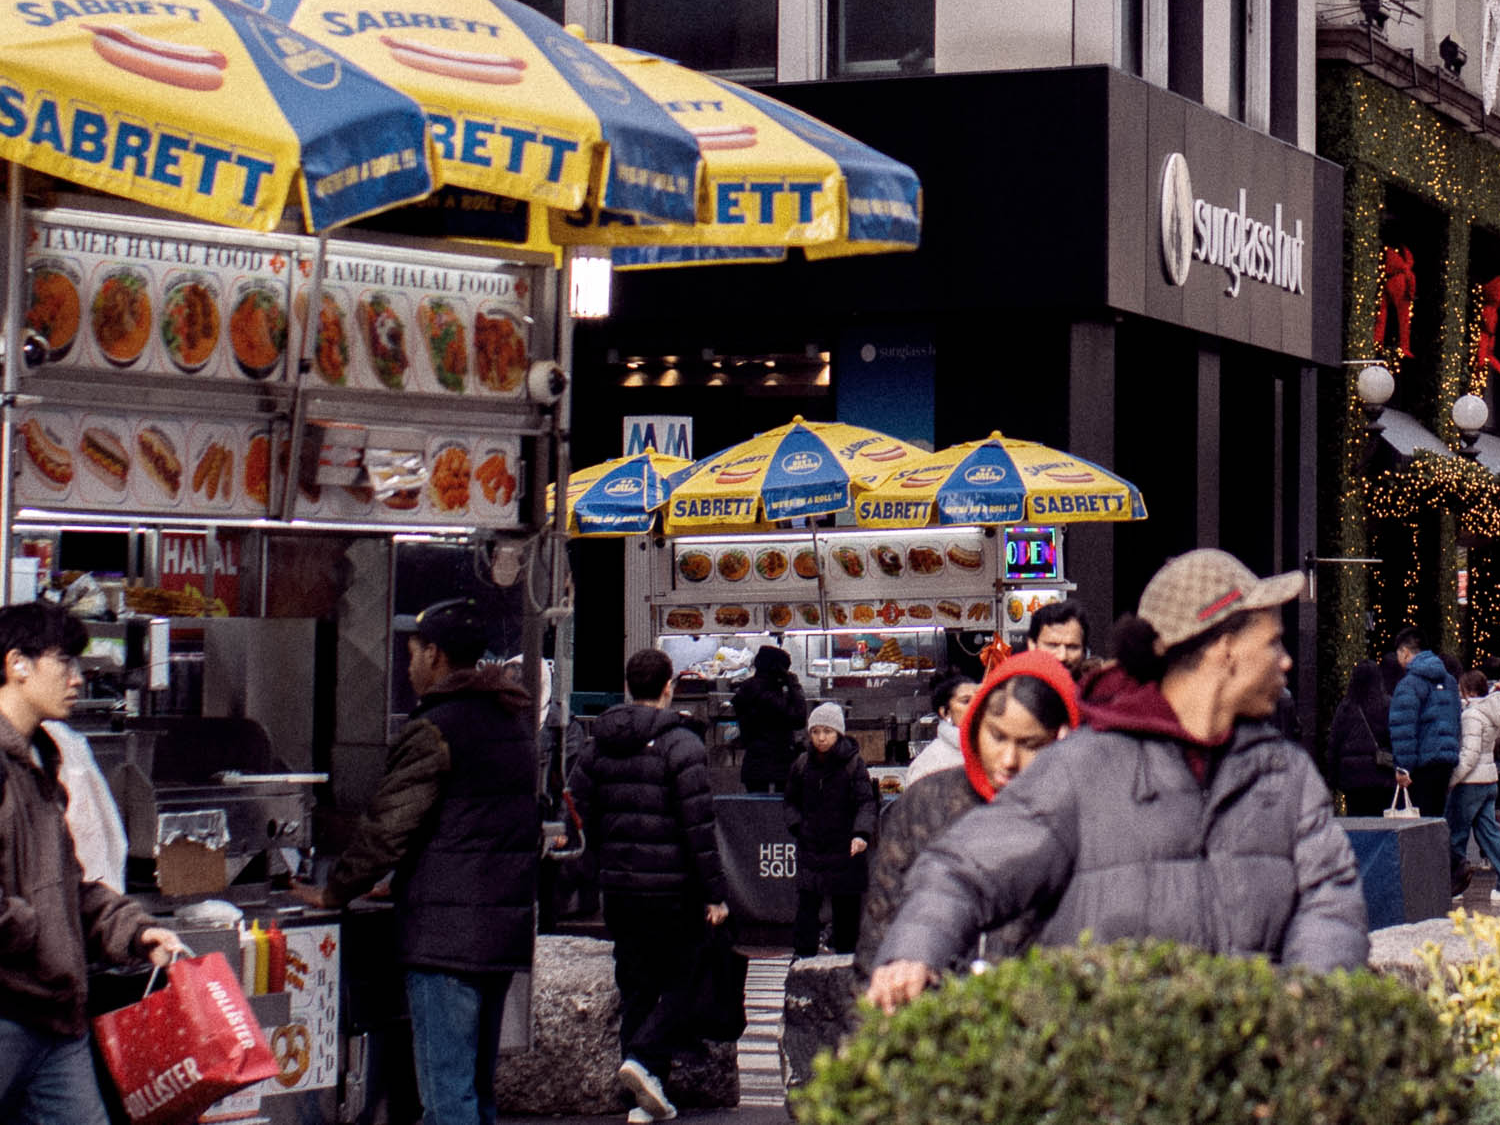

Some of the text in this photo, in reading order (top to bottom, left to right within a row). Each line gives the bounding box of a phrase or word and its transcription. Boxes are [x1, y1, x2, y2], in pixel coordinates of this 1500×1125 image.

[322, 11, 500, 38] SABRETT
[0, 85, 275, 207] SABRETT
[42, 227, 263, 271] TAMER HALAL FOOD
[1275, 203, 1305, 295] hut
[392, 266, 449, 291] HALAL
[458, 274, 510, 297] FOOD
[674, 498, 754, 518] SABRETT
[860, 501, 931, 521] SABRETT
[1033, 494, 1125, 515] SABRETT
